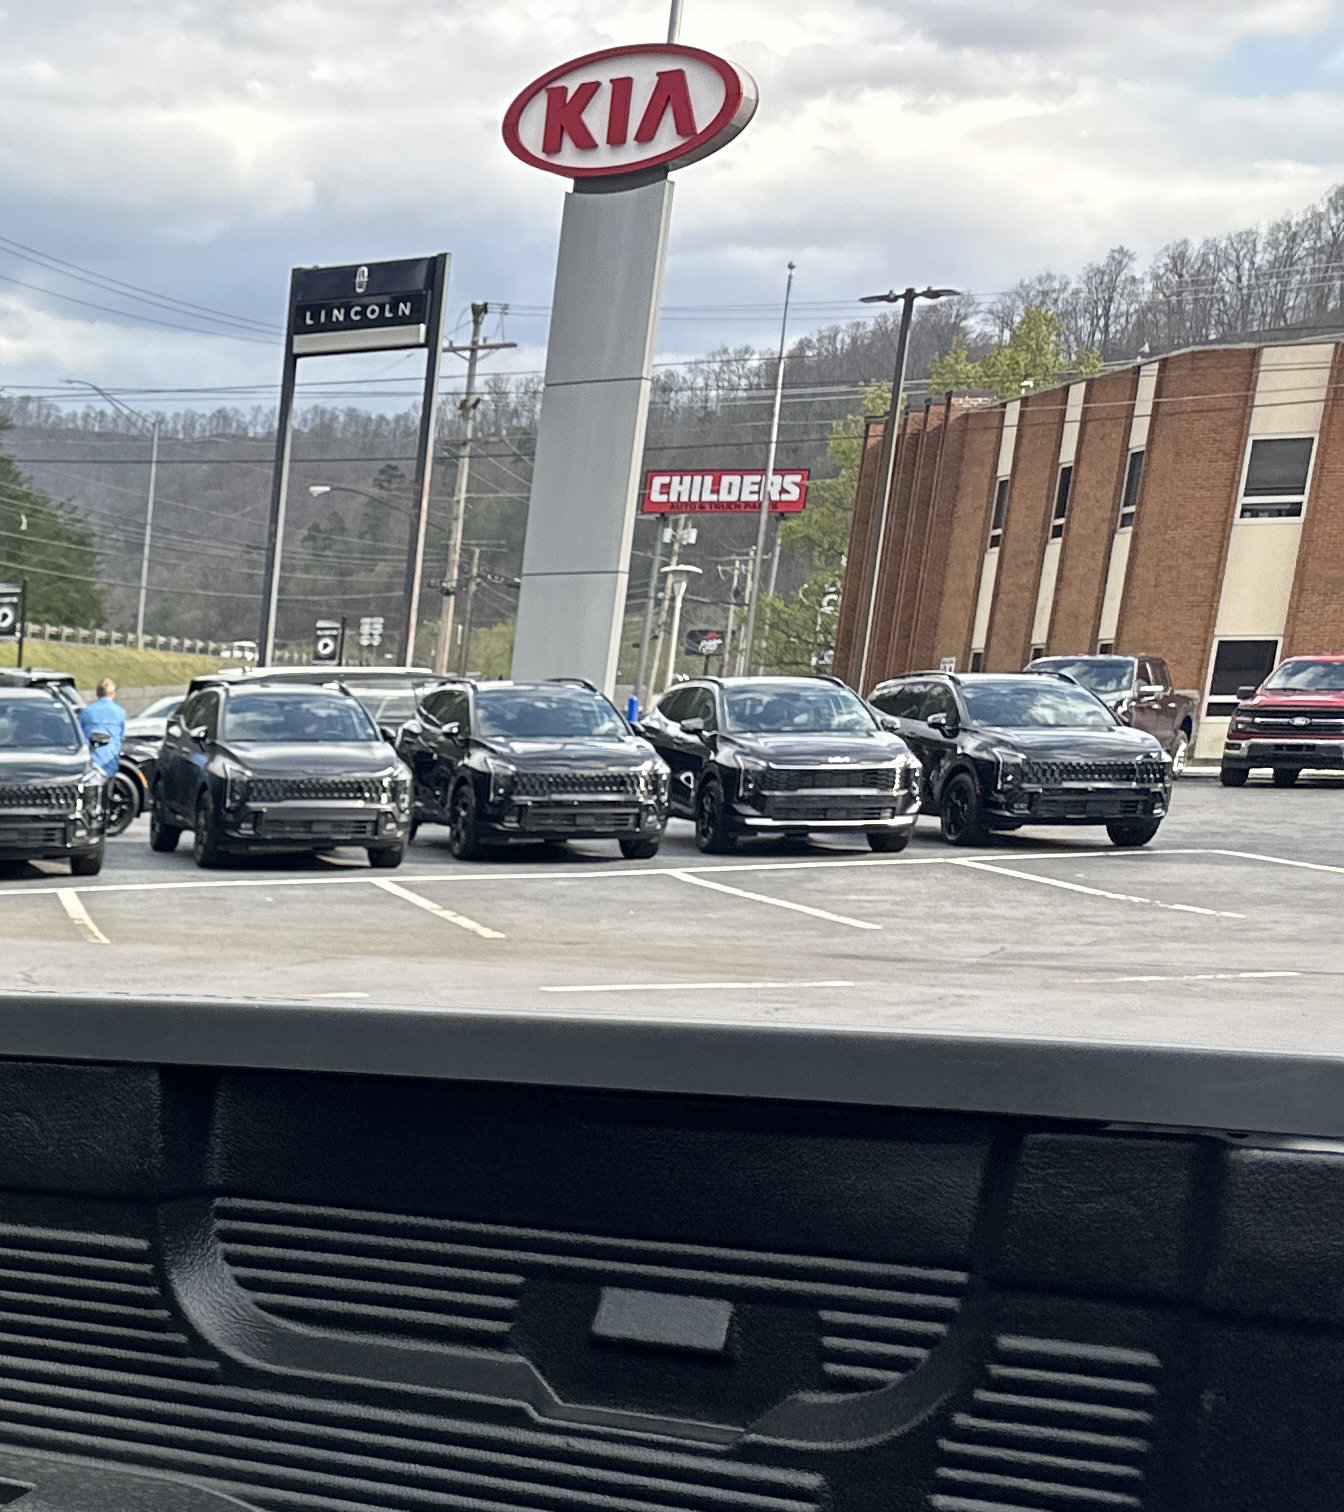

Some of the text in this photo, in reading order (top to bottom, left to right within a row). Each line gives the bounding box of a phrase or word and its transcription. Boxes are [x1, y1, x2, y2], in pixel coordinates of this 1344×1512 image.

[542, 69, 699, 155] KIA
[305, 301, 411, 325] LINCOLN
[650, 474, 802, 502] CHILDERS
